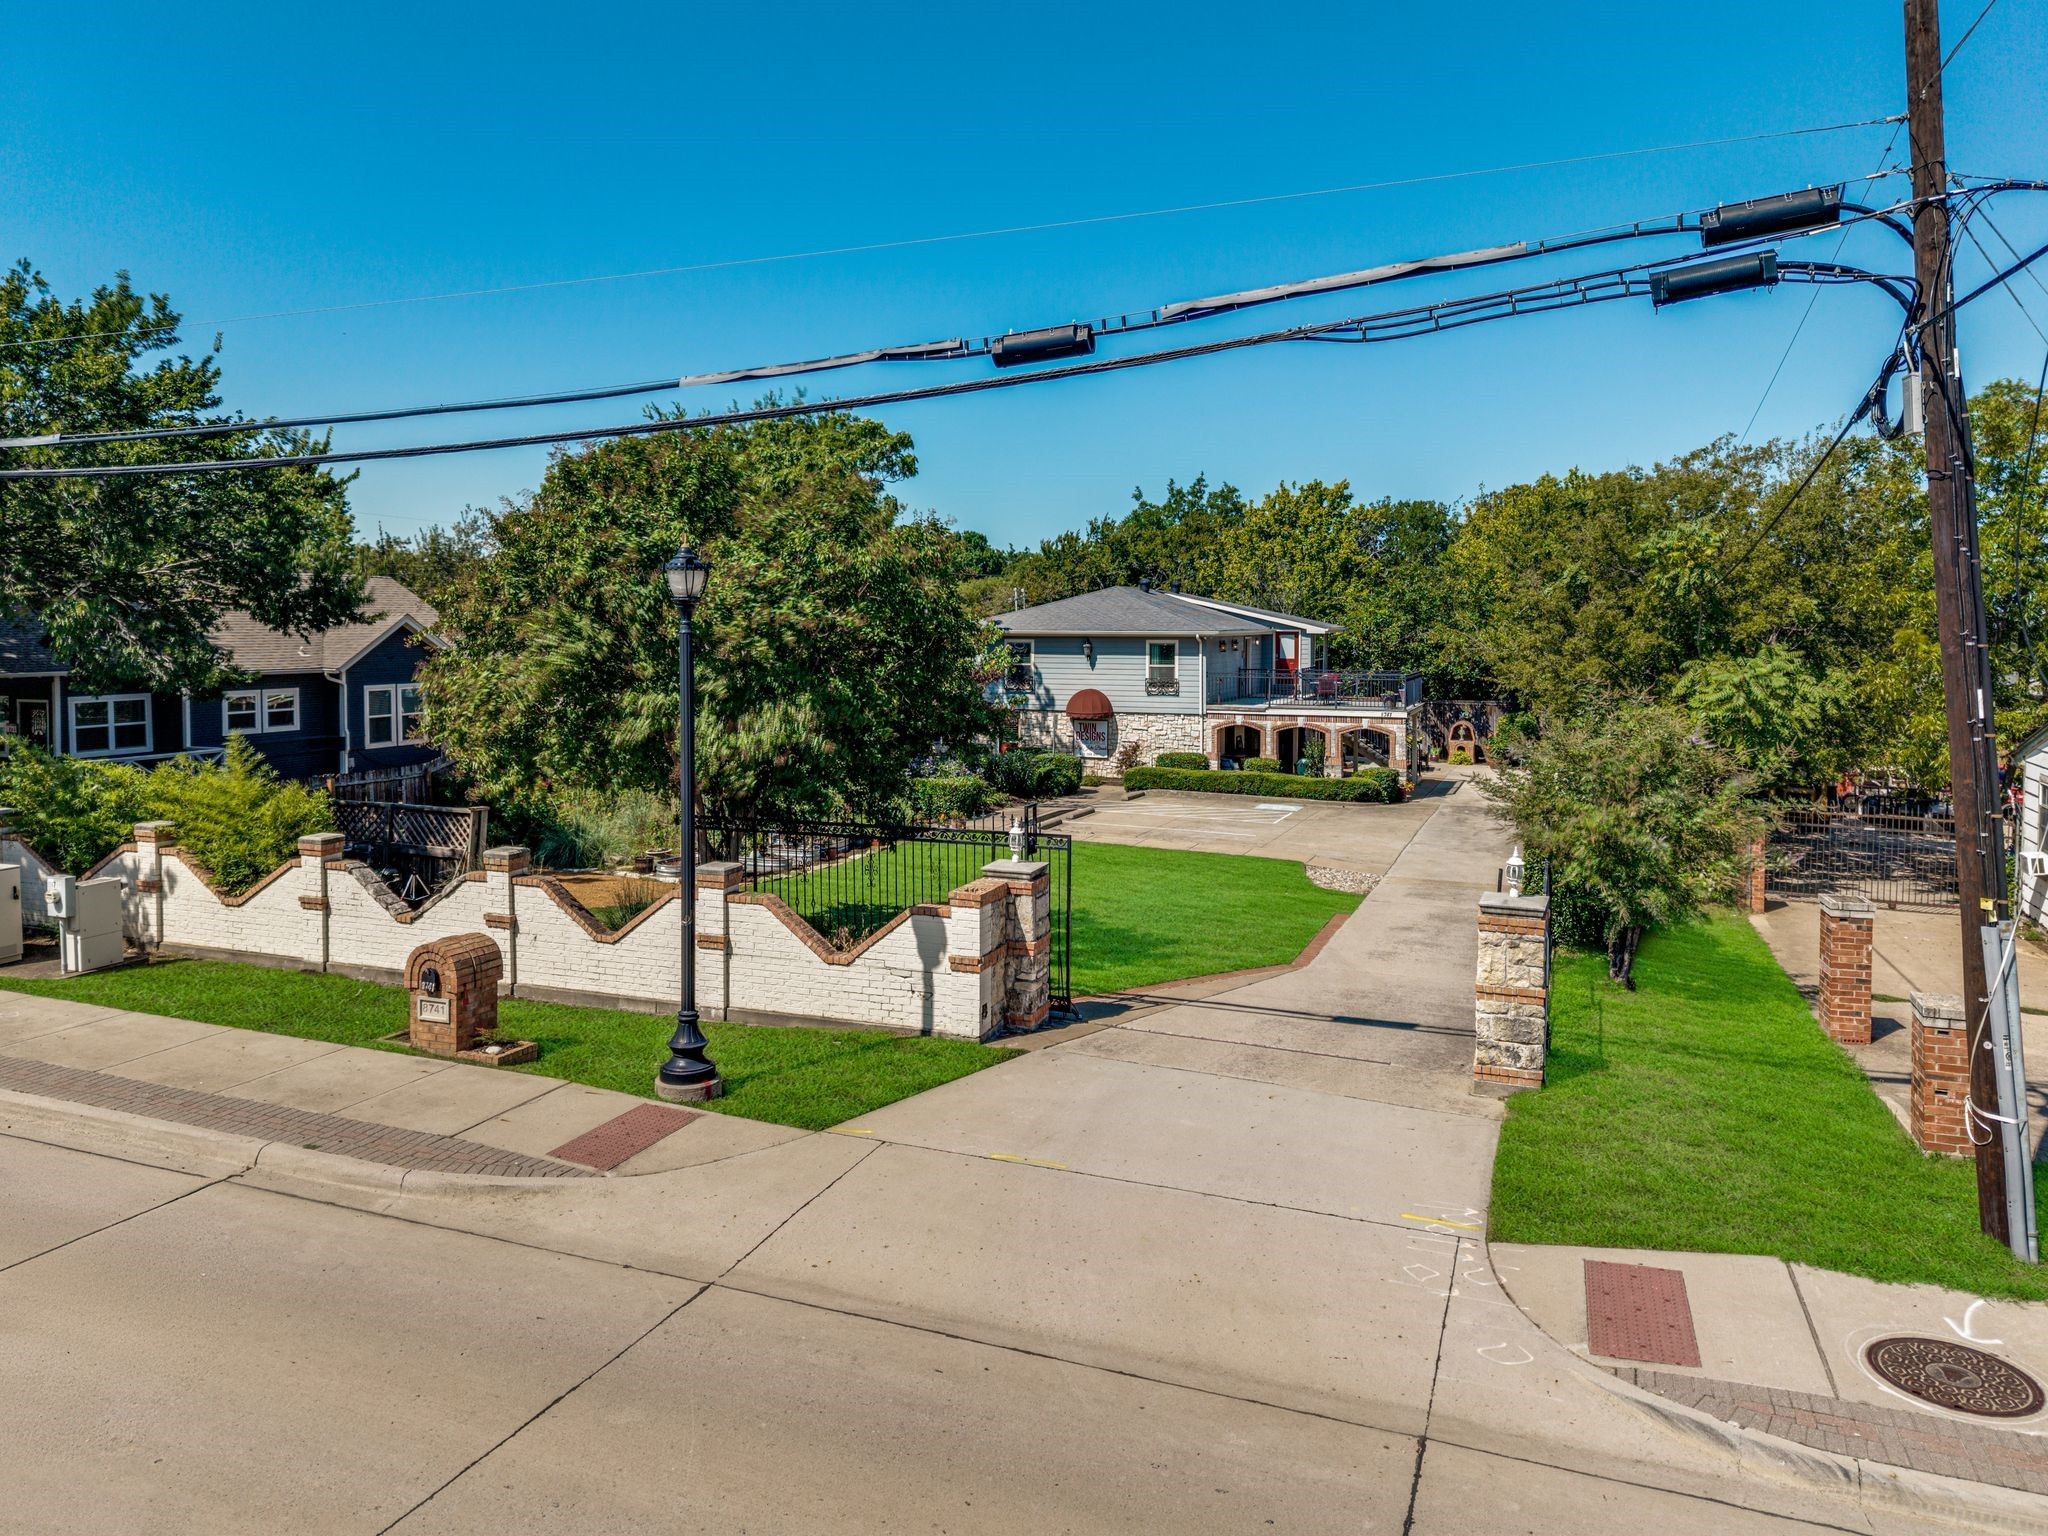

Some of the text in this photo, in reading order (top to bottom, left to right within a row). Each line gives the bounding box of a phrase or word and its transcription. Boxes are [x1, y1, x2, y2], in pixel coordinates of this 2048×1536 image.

[1079, 723, 1096, 732] TWIN
[1076, 731, 1105, 741] DESIGNS
[423, 1003, 445, 1014] 8741
